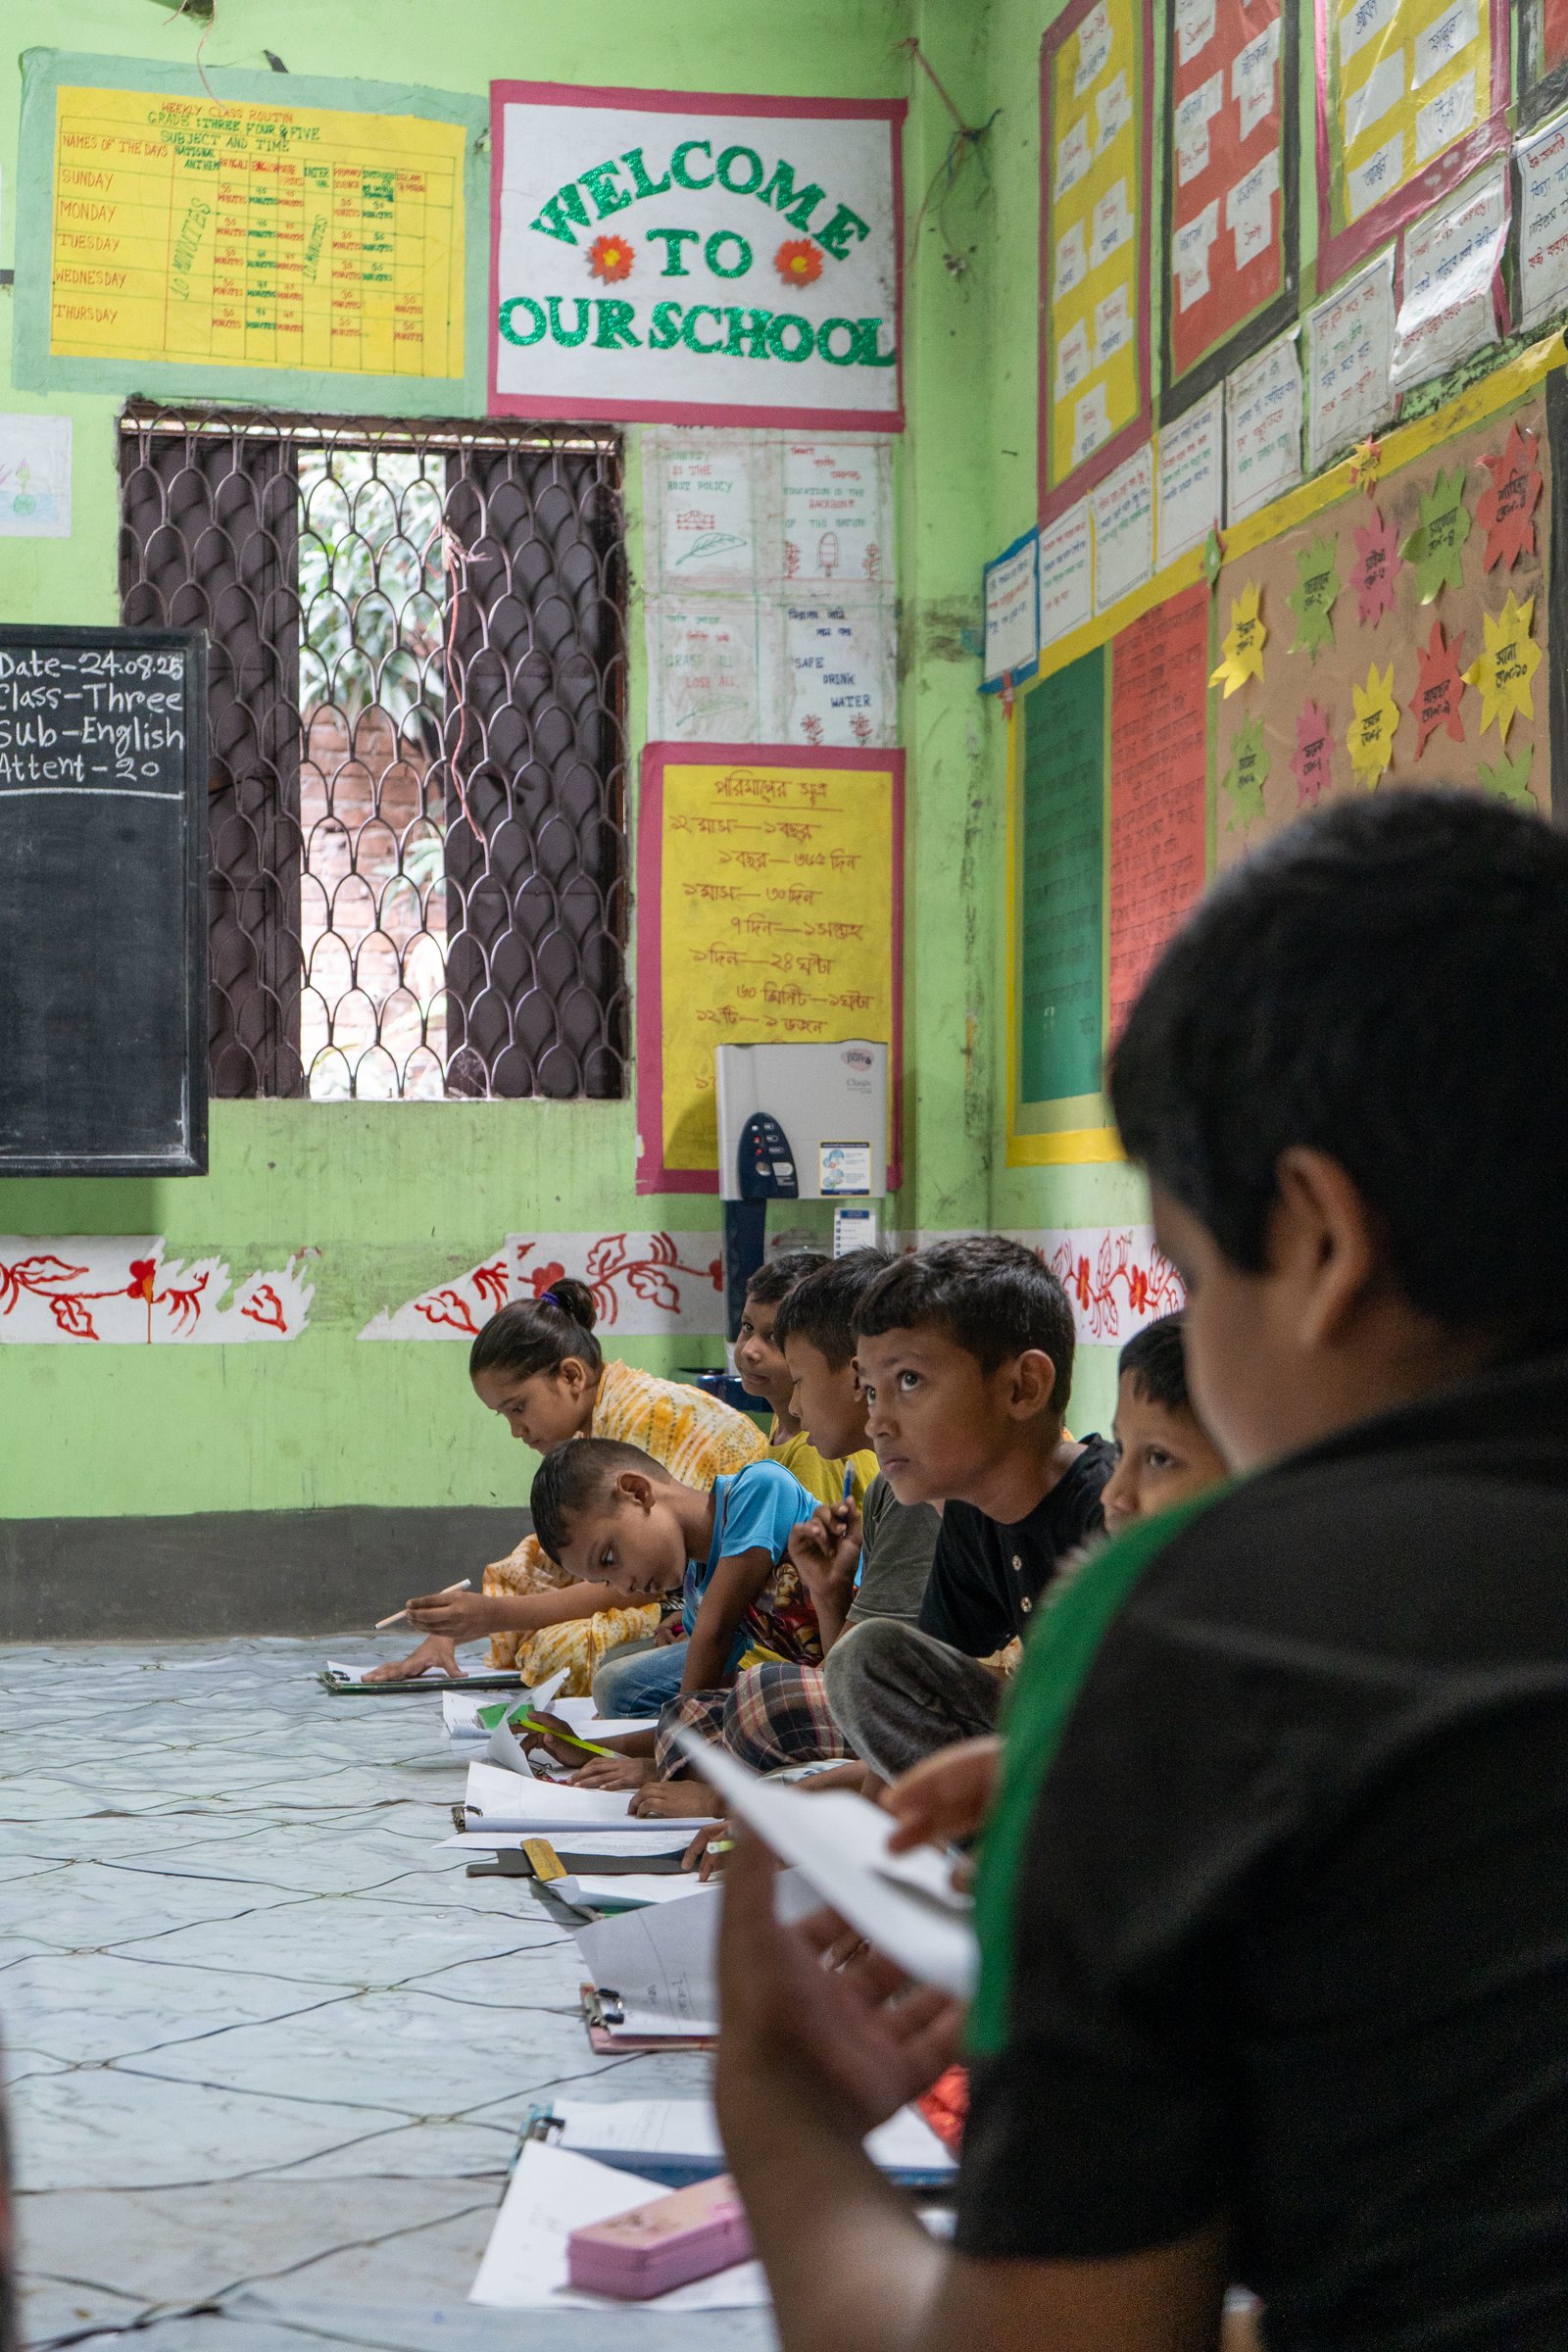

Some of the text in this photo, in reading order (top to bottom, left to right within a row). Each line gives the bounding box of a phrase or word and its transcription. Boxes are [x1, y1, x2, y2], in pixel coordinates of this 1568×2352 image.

[209, 106, 242, 119] CLASS
[160, 130, 290, 152] SUBJECT AND TIME
[290, 126, 320, 141] FIVE
[63, 135, 168, 158] NAMES OF THE DAYS
[62, 169, 113, 192] SUNDAY
[529, 139, 871, 261] WELCOME
[60, 201, 116, 223] MONDAY
[58, 233, 120, 253] TUESDAY
[645, 227, 753, 278] TO
[55, 269, 126, 289] WEDNESDAY
[54, 305, 118, 324] THURSDAY
[498, 296, 897, 368] OUR SCHOOL
[795, 657, 824, 668] SAFE
[823, 672, 856, 685] DRINK
[830, 694, 871, 708] WATER
[0, 752, 85, 783] Attent
[116, 757, 160, 782] 20
[830, 848, 861, 871] দিন
[787, 883, 823, 905] দিন
[731, 916, 741, 934] ৭
[743, 912, 782, 937] দিন
[709, 941, 747, 966] দিন
[769, 953, 792, 972] ২৪
